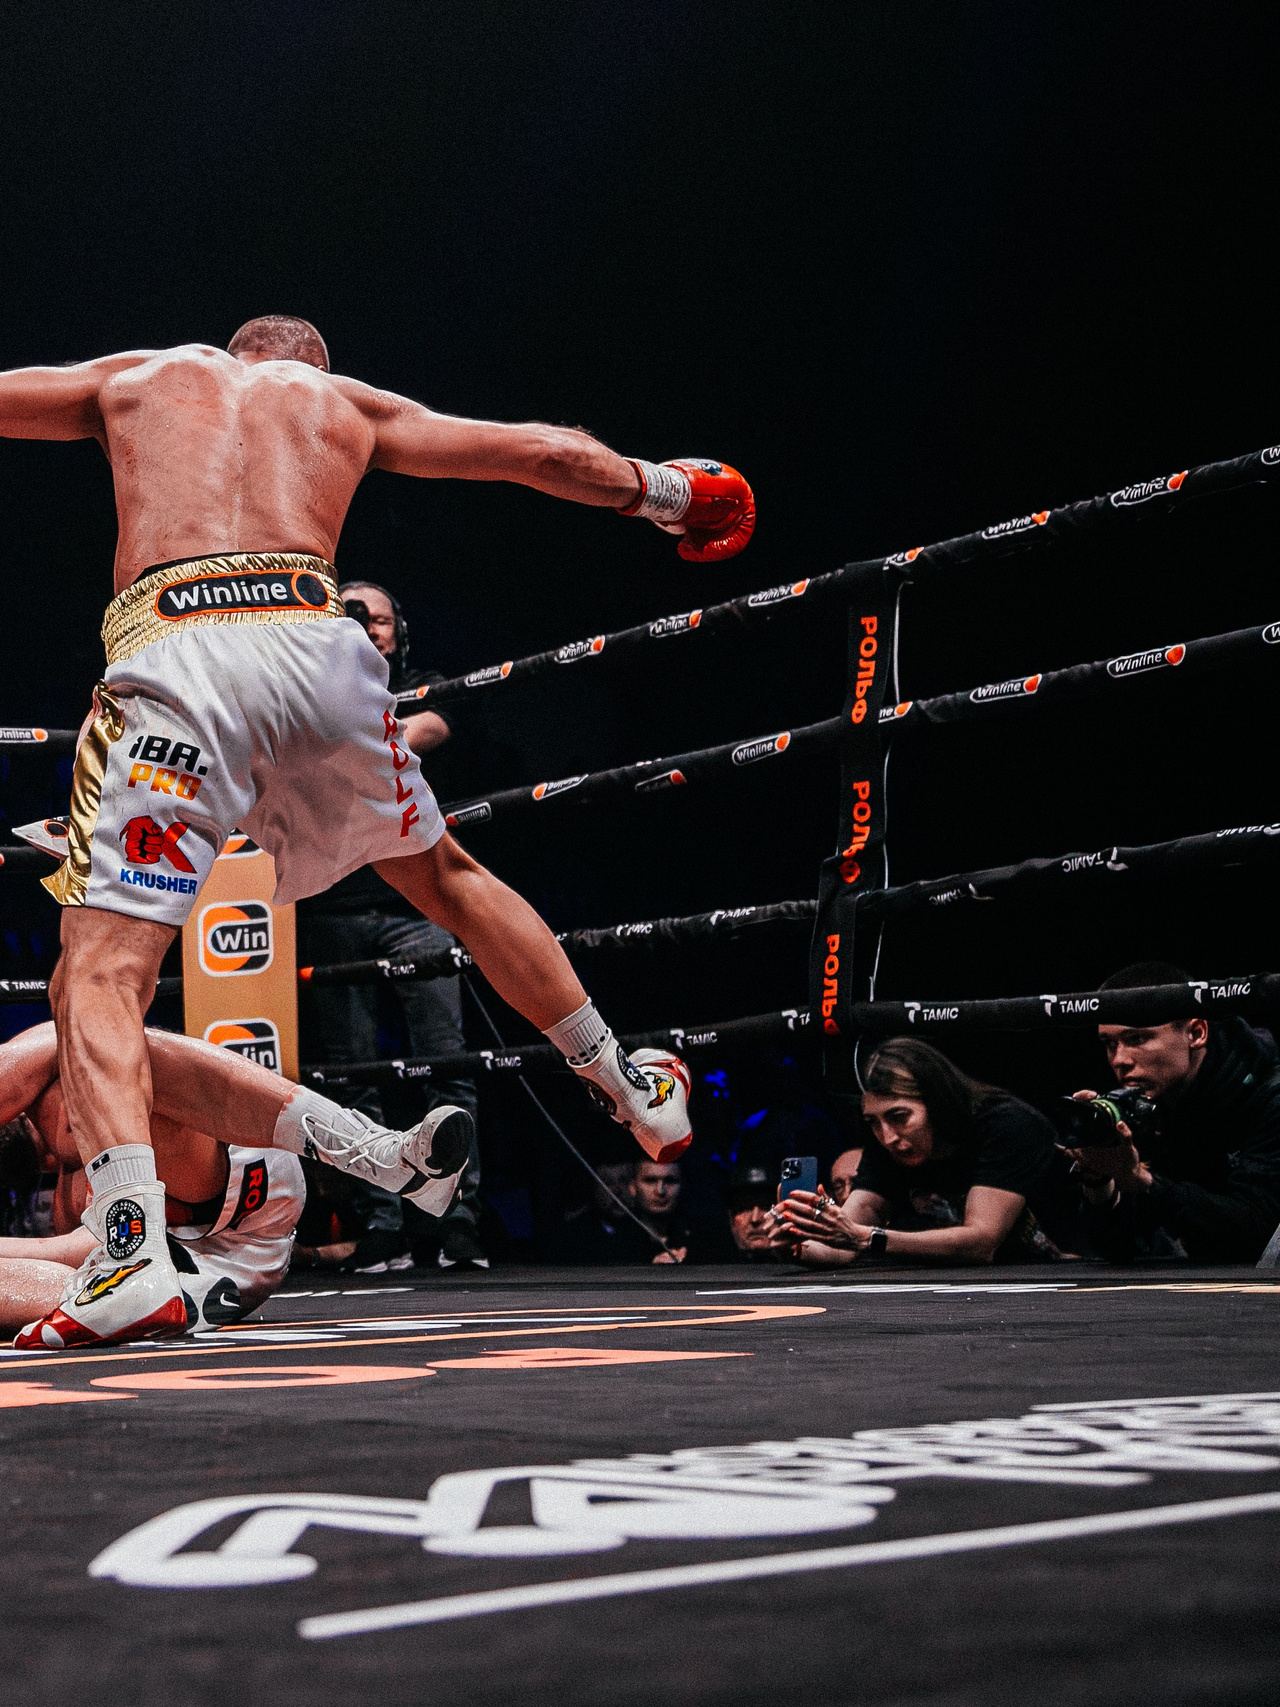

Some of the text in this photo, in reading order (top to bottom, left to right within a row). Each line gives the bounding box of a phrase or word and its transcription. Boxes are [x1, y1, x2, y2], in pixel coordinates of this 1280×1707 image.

[168, 580, 289, 610] Winline
[851, 616, 878, 724] РОЛЬФ
[1115, 651, 1162, 674] Winline
[976, 680, 1021, 699] Winline
[736, 740, 774, 763] Winline
[127, 763, 202, 800] PRO
[1063, 852, 1104, 873] TAMIC
[120, 868, 199, 895] KRUSHER
[12, 981, 47, 991] TAMIC
[1210, 982, 1251, 998] TAMIC
[922, 1007, 959, 1022] TAMIC
[1059, 998, 1100, 1014] TAMIC
[686, 1031, 718, 1046] TAMIC
[109, 1220, 142, 1242] RUS
